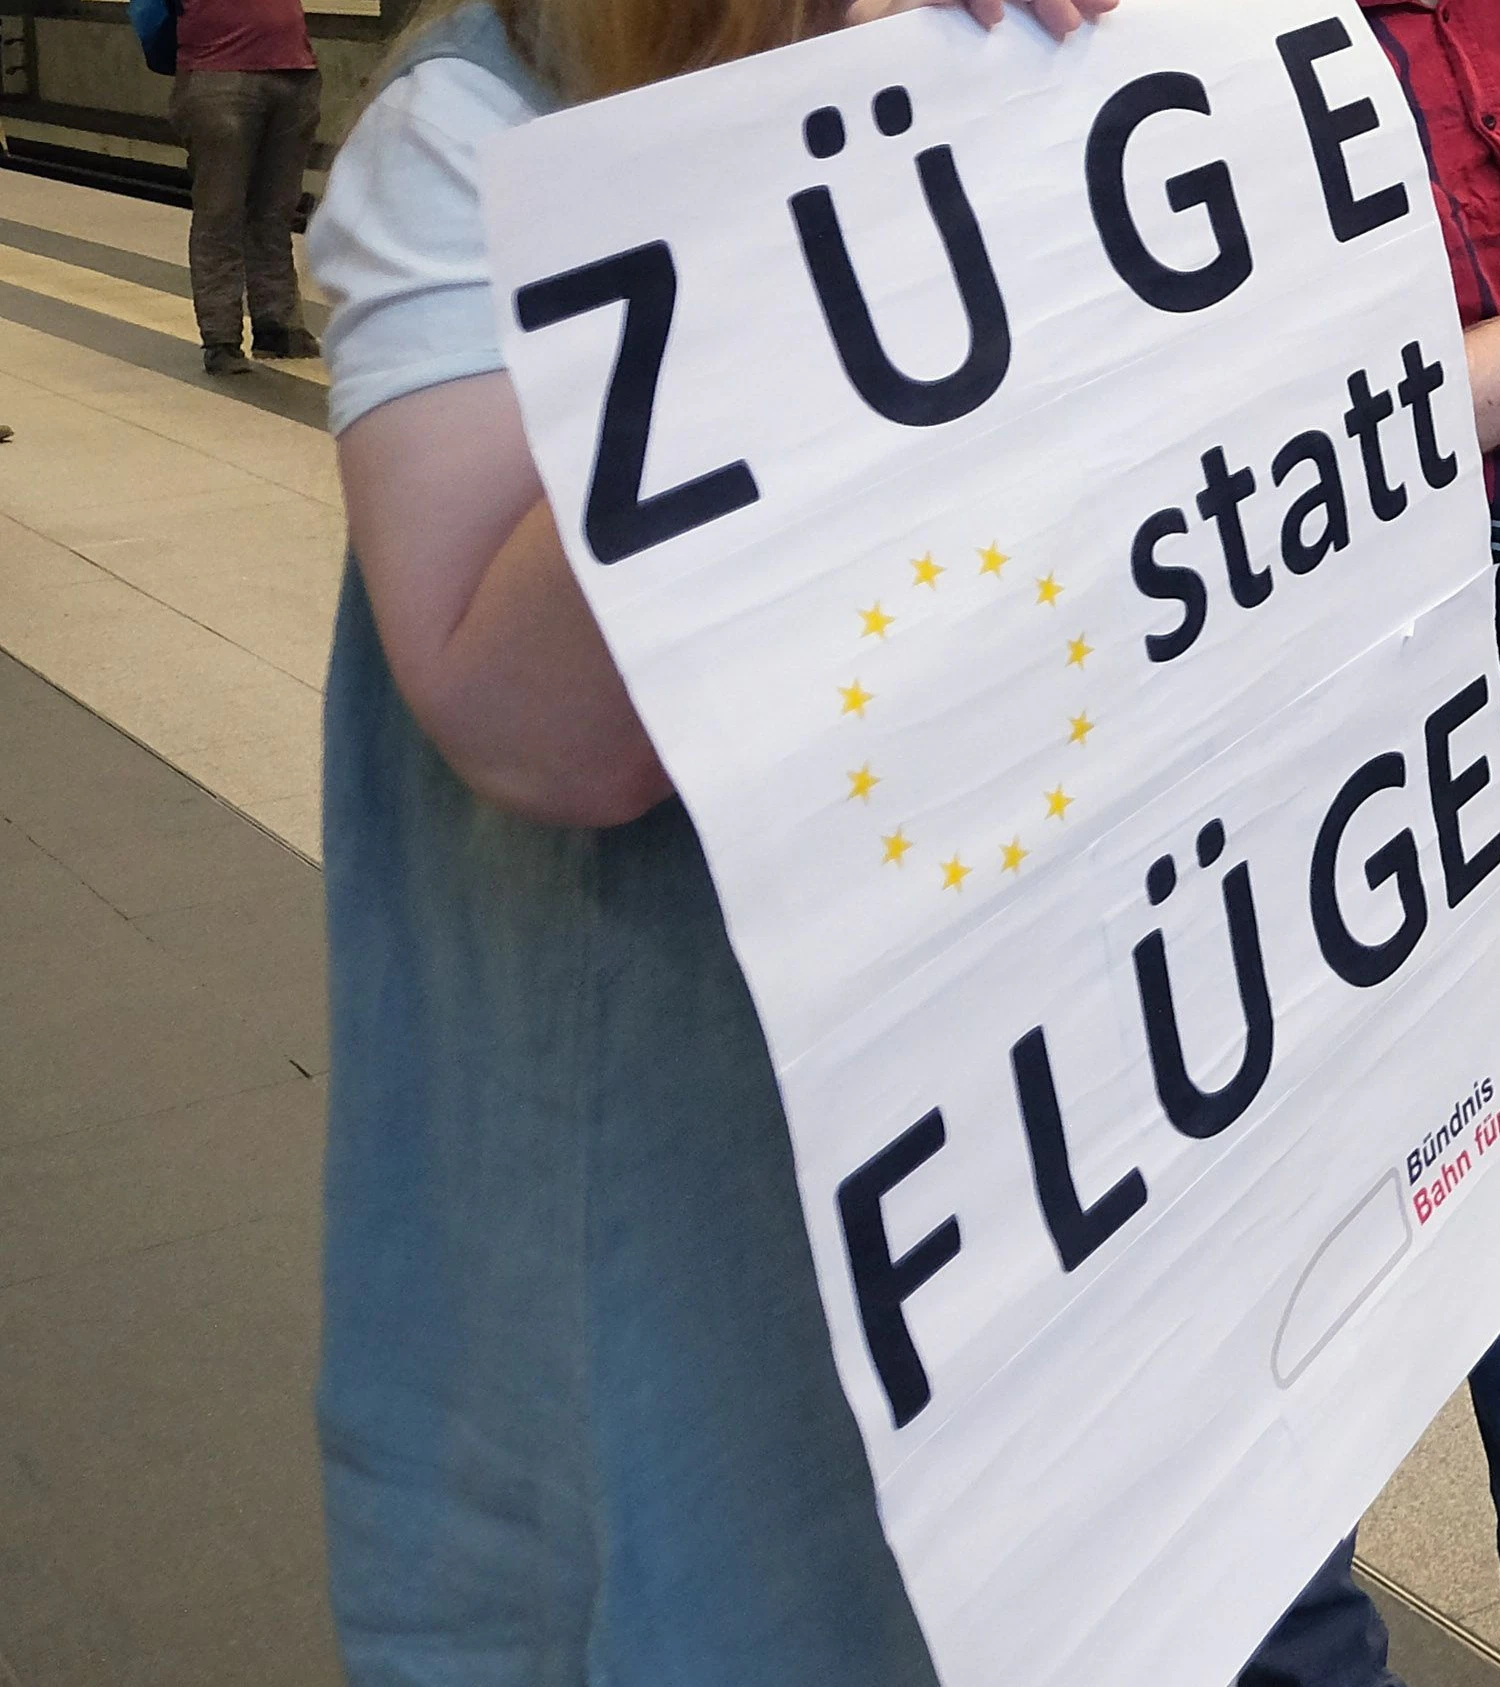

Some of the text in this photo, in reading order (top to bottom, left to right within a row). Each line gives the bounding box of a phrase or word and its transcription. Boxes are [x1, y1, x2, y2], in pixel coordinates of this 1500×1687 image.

[512, 16, 1408, 565] ZÜGE
[1130, 342, 1460, 665] statt
[1406, 1076, 1495, 1186] Bündnis
[1412, 1149, 1473, 1226] Bahn
